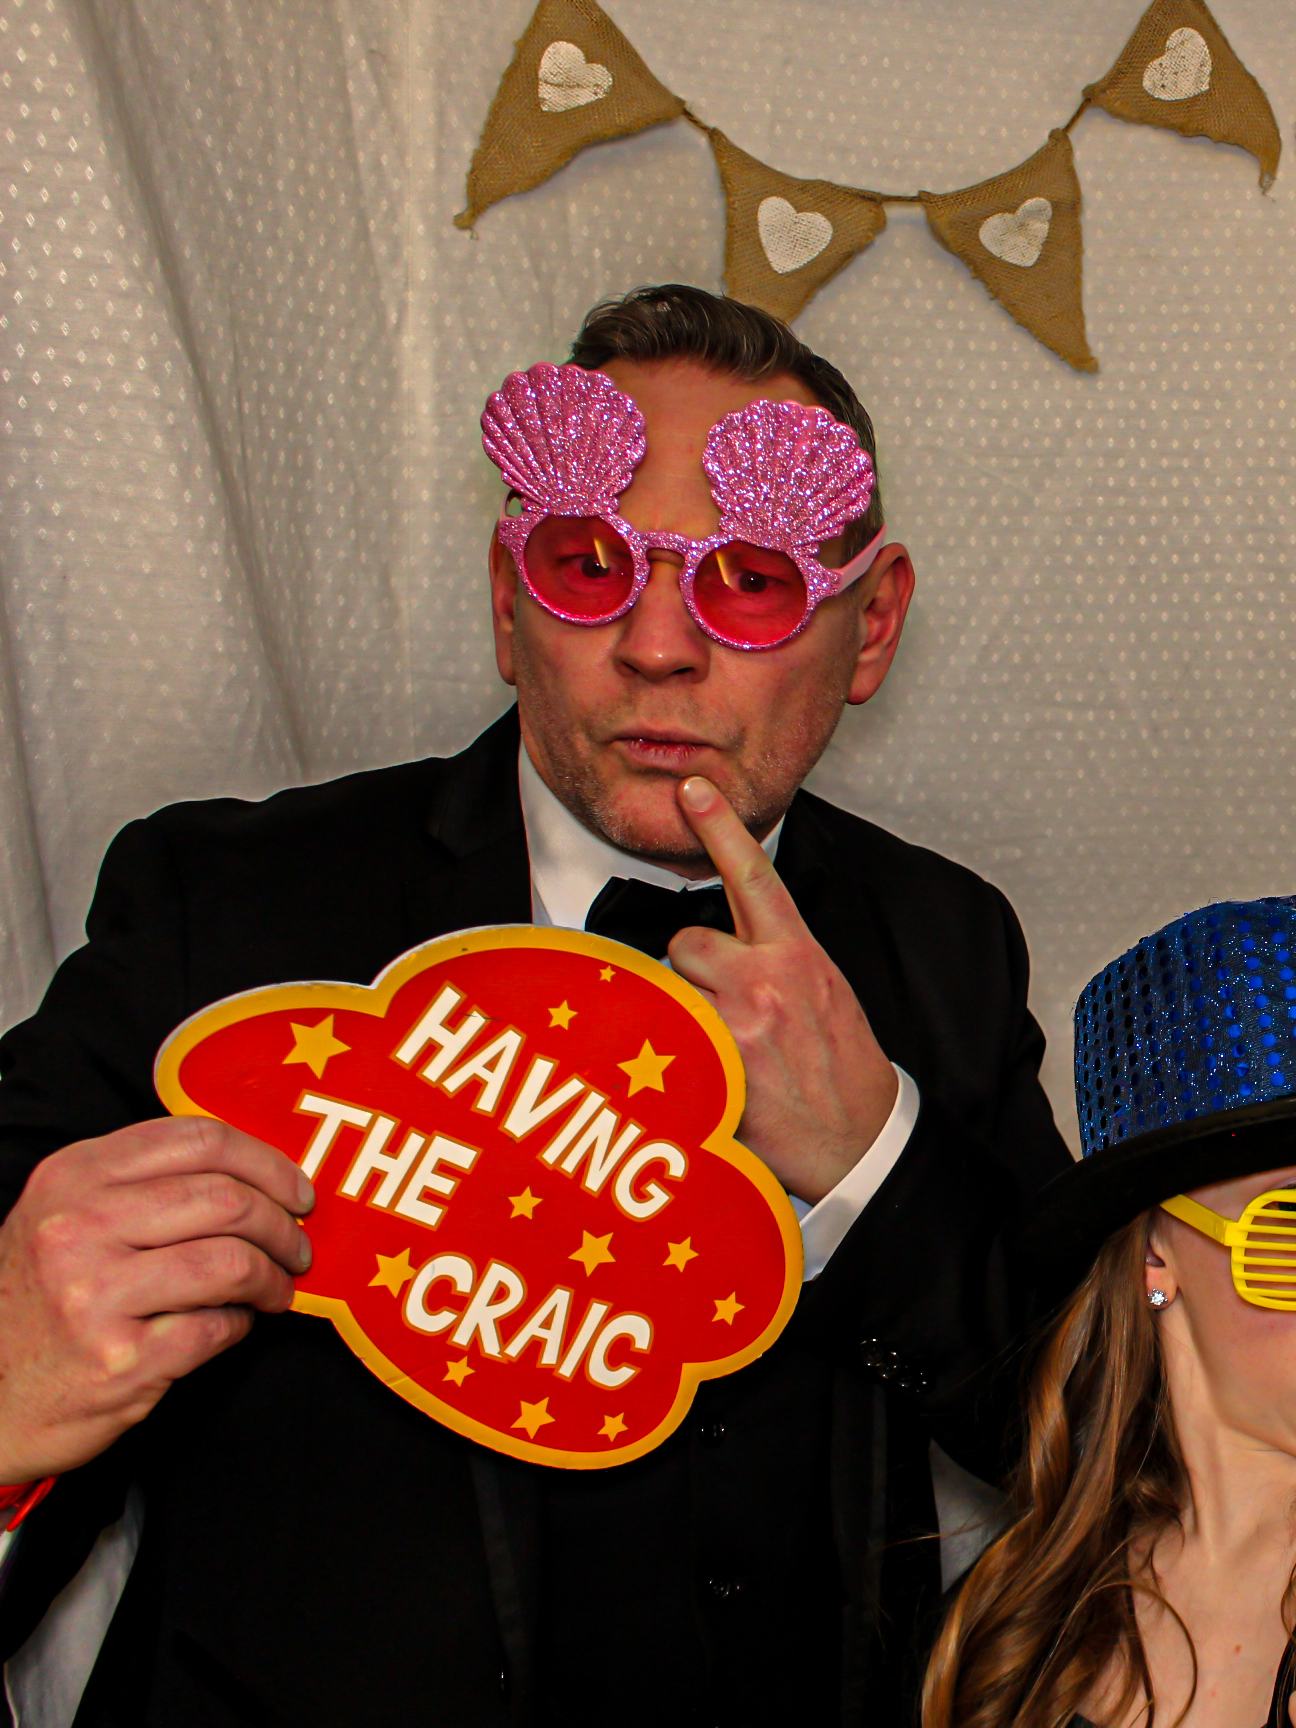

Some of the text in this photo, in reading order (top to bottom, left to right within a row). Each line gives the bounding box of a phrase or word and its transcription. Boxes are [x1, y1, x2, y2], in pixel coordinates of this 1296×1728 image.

[299, 1094, 479, 1228] THE
[396, 986, 687, 1219] HAVING
[405, 1254, 653, 1388] CRAIC
